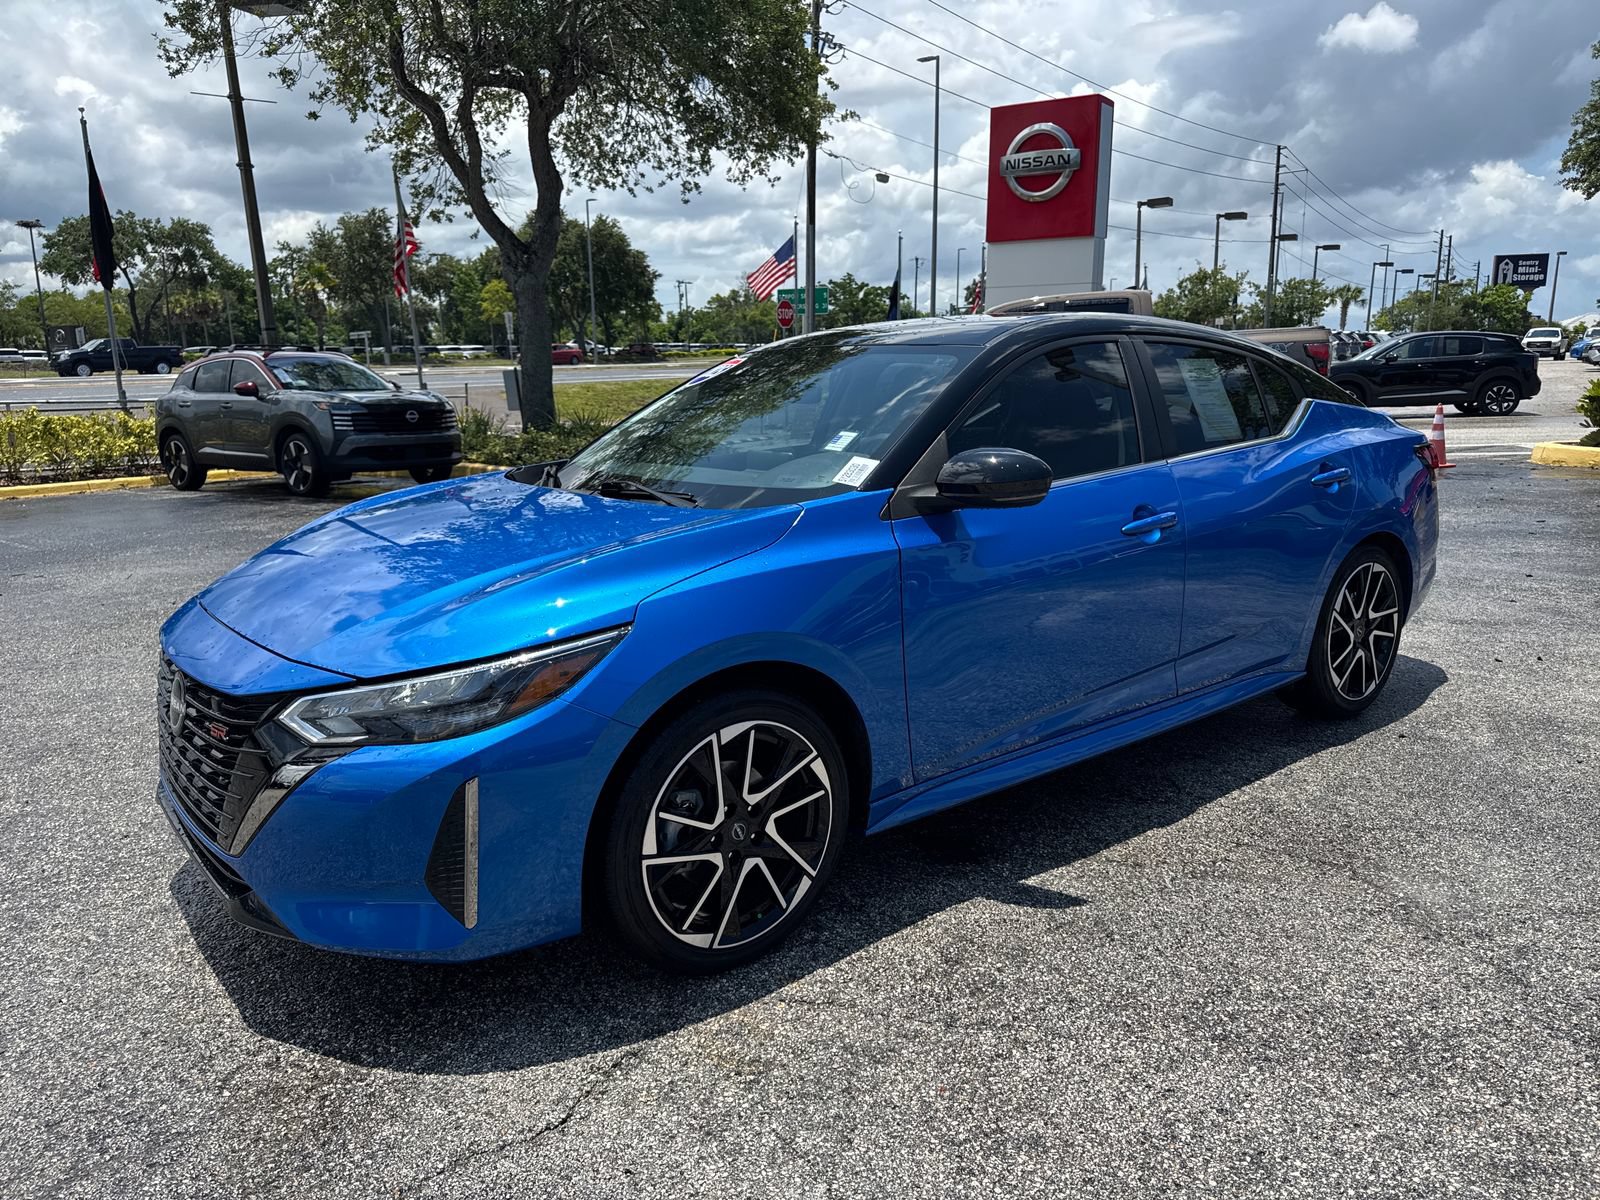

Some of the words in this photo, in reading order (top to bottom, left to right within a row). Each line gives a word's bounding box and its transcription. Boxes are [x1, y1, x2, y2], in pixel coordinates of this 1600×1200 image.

[1006, 154, 1071, 171] NISSAN
[778, 308, 794, 320] STOP
[210, 721, 227, 740] SR
